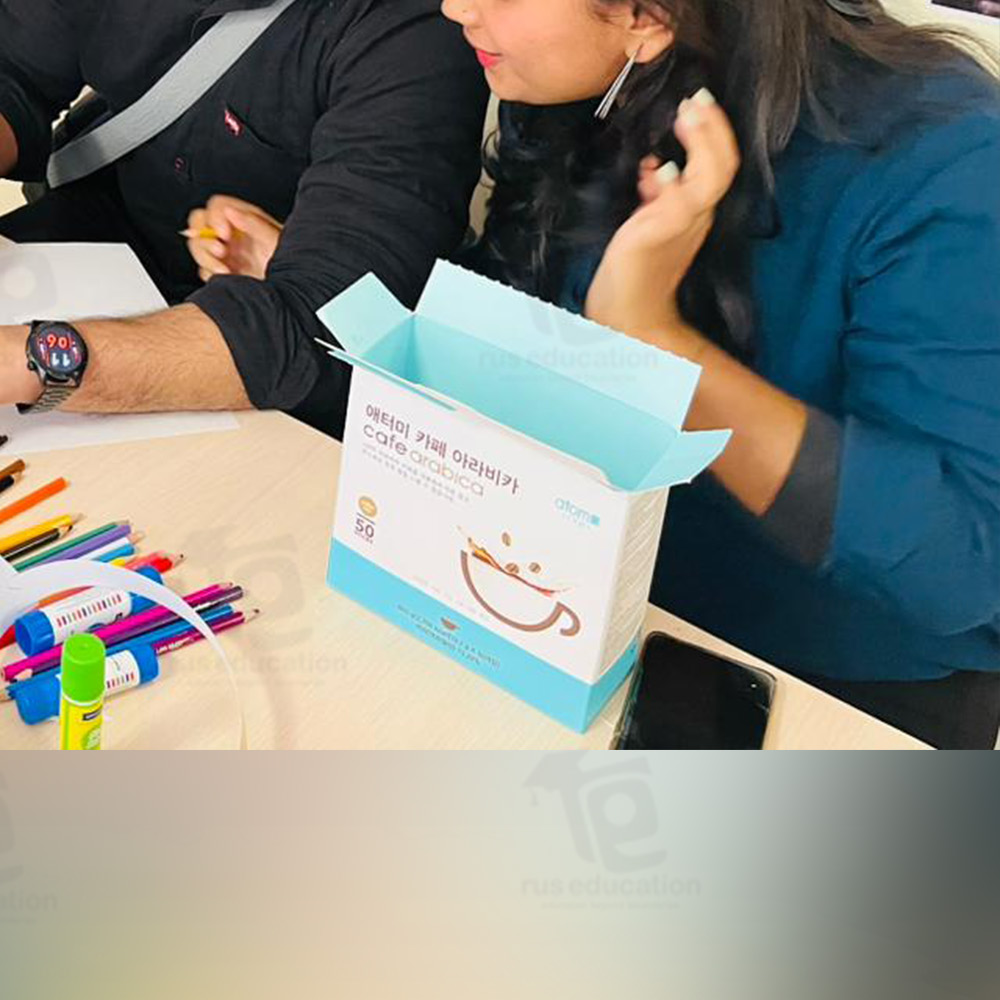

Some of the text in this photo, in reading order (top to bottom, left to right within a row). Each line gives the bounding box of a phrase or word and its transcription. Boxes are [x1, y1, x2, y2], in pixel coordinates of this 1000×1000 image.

[363, 424, 408, 456] cafe
[409, 449, 485, 497] arabica
[366, 404, 410, 440] 애터미
[415, 430, 448, 459] 카페
[452, 449, 519, 495] 아라비카
[355, 518, 375, 538] 50
